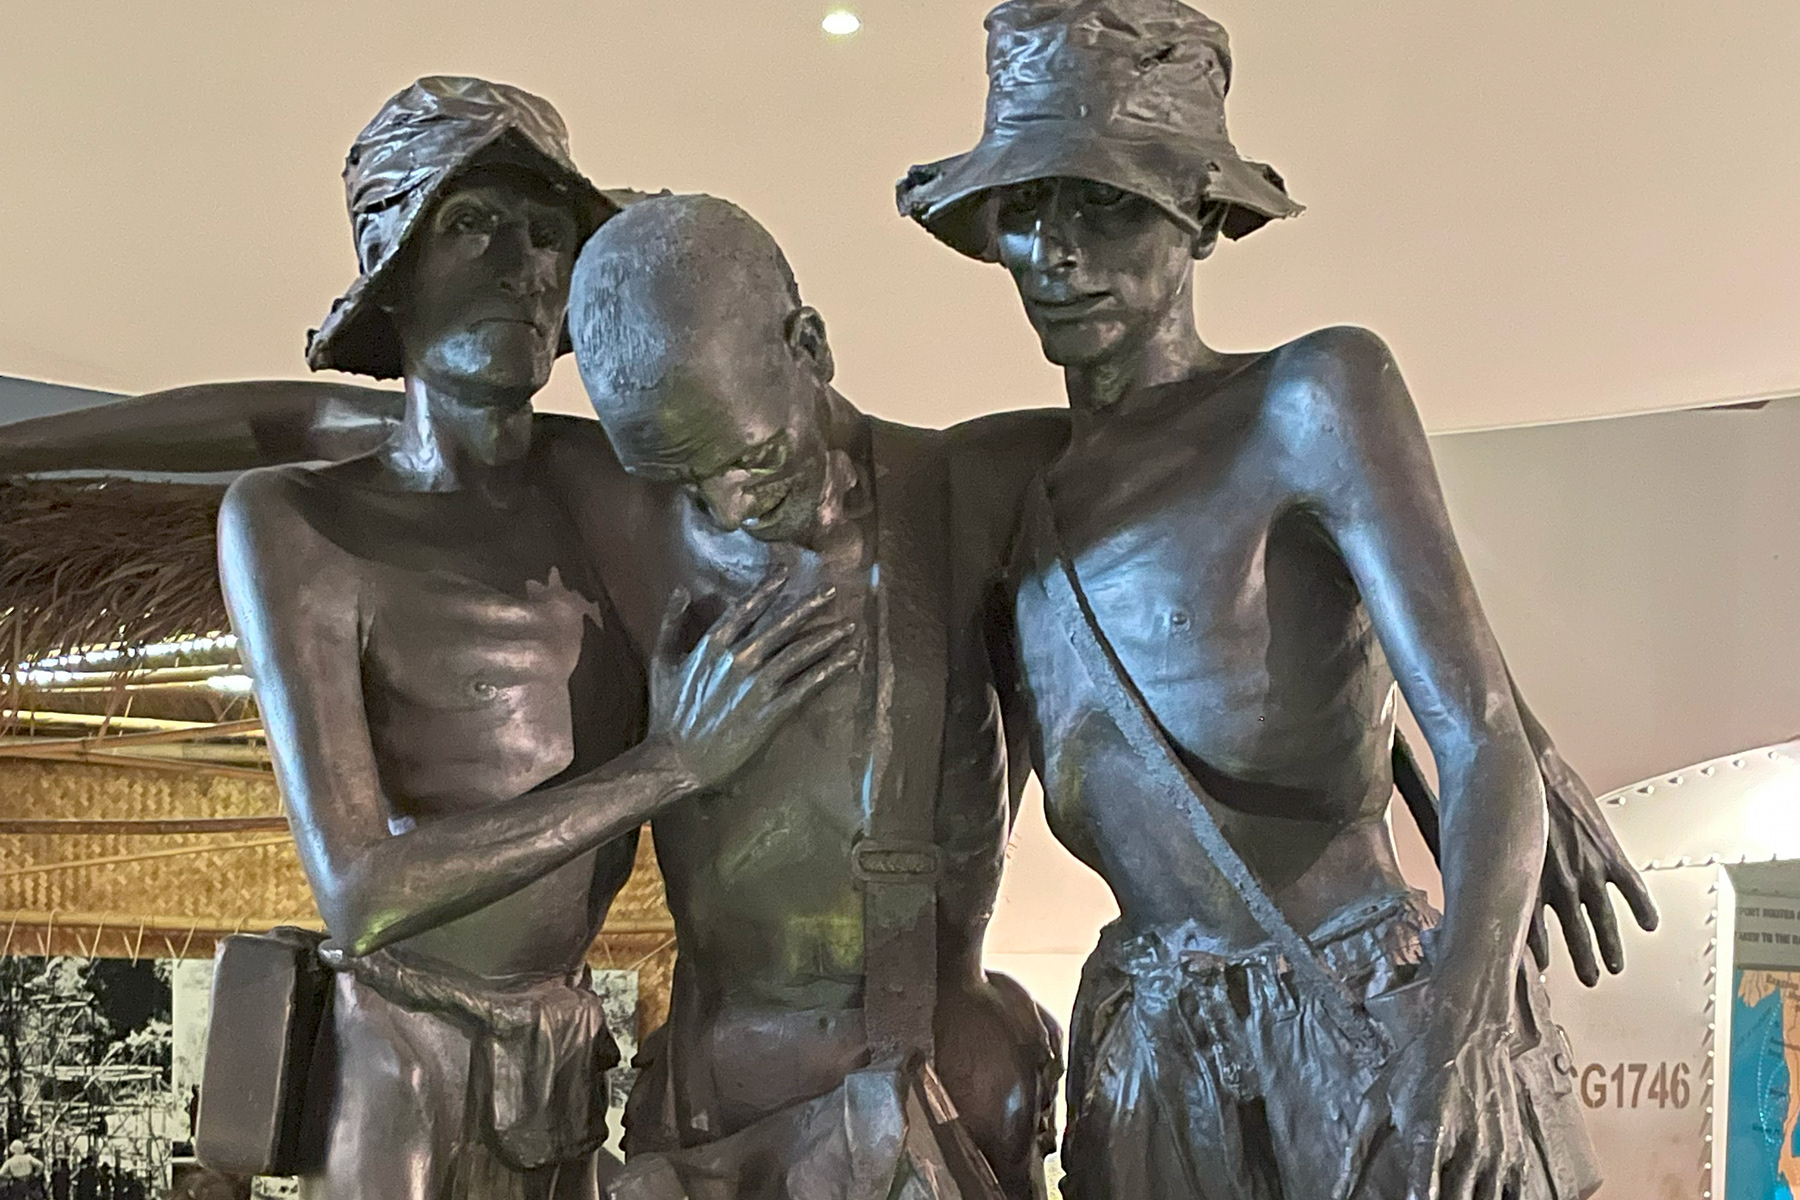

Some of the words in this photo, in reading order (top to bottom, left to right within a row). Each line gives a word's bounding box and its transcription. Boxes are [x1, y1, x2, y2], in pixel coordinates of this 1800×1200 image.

[1761, 932, 1773, 943] TO
[1775, 932, 1791, 944] THE
[1571, 1062, 1690, 1109] G1746
